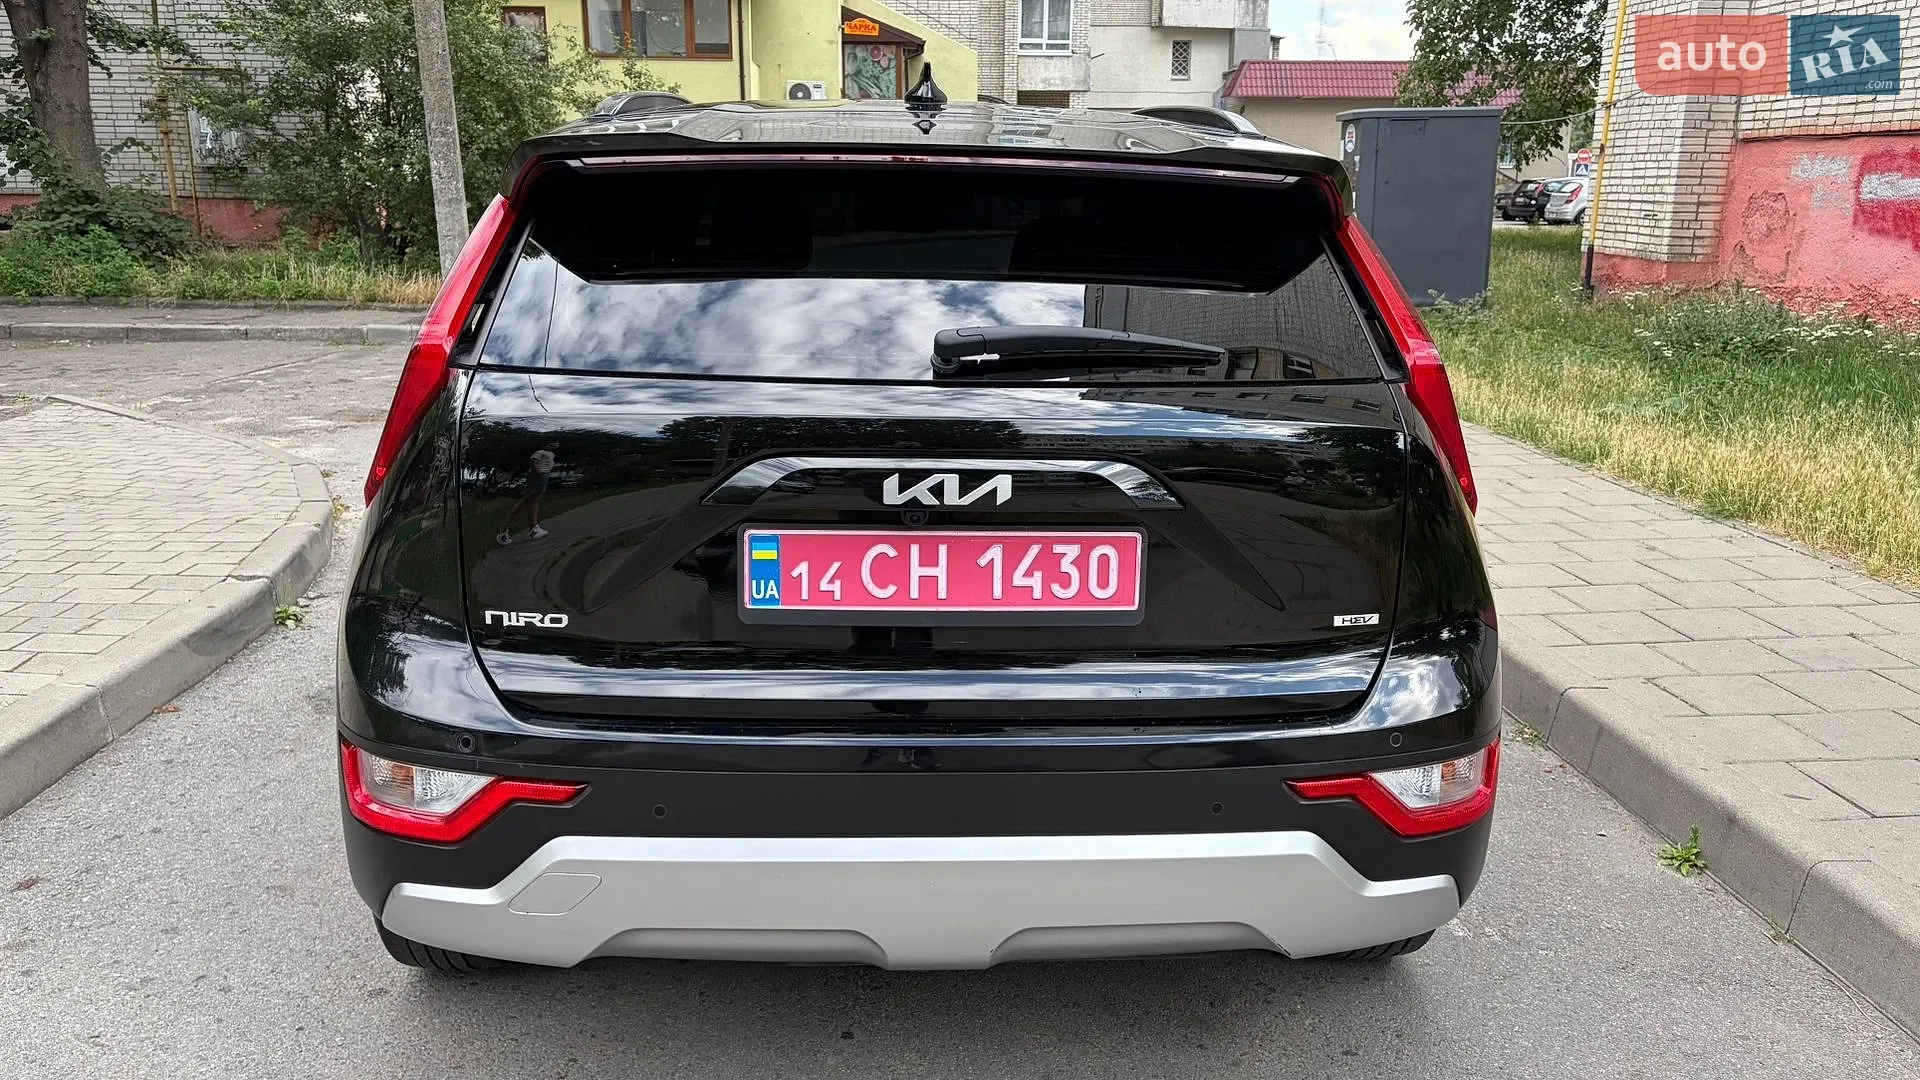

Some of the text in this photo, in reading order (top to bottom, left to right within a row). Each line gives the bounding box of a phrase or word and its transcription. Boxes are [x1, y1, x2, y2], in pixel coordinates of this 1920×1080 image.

[883, 474, 1012, 505] KIA
[790, 543, 1119, 601] 14 CH 1430
[751, 580, 779, 599] UA
[485, 611, 569, 628] NIRO
[1342, 616, 1374, 625] HEV
